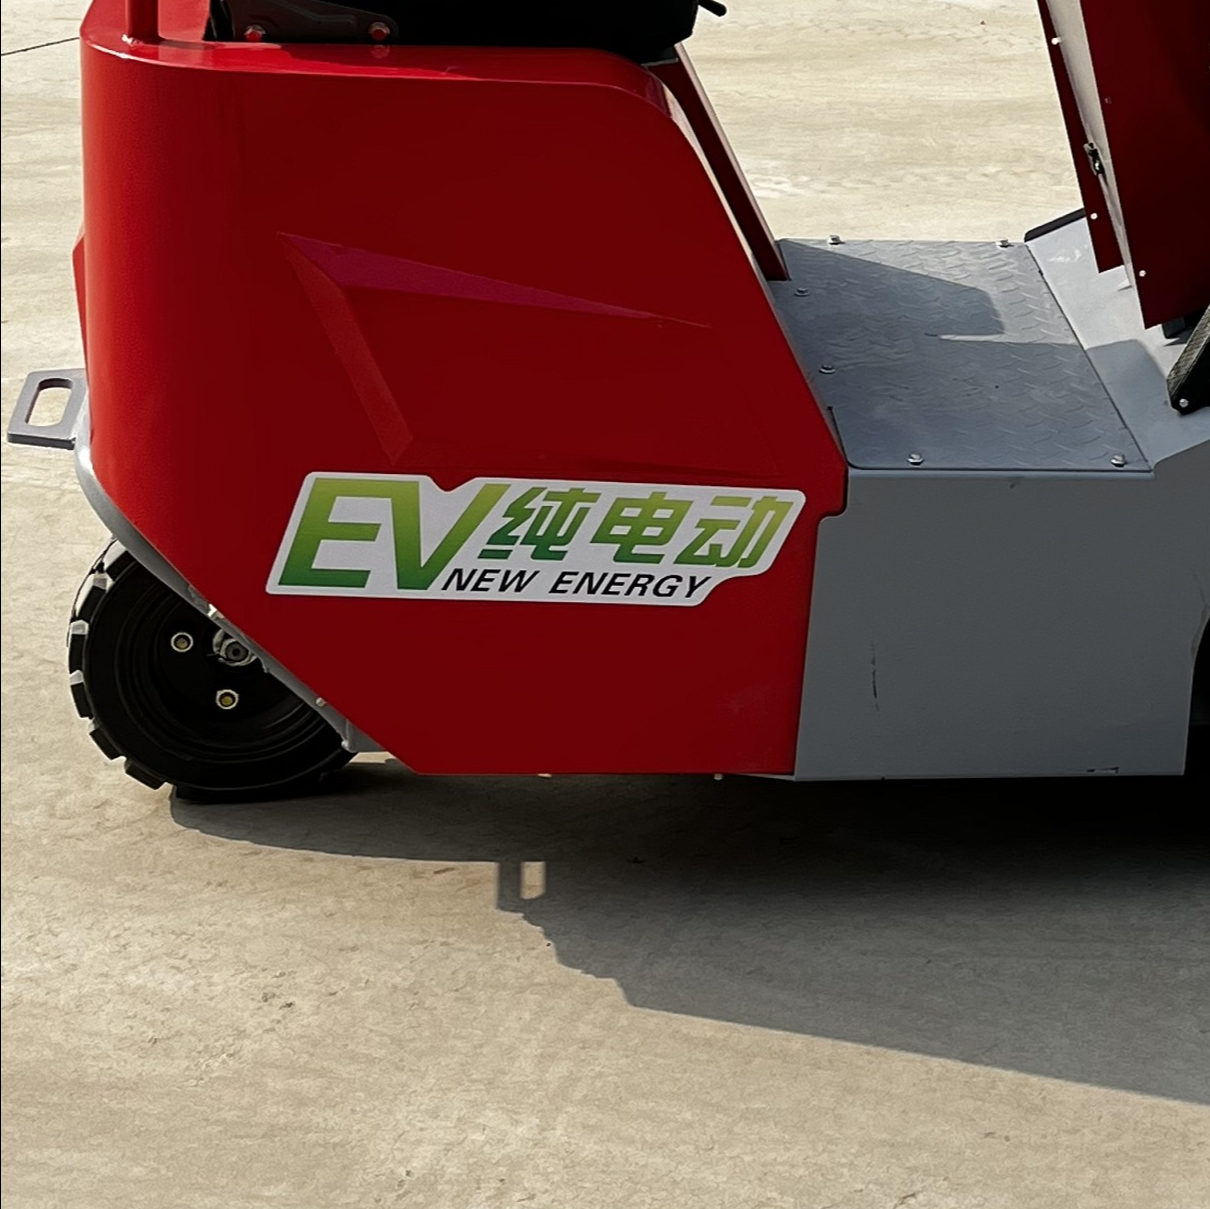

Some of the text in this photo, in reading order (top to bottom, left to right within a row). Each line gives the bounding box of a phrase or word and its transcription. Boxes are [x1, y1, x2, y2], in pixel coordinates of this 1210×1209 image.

[278, 476, 794, 590] EV 纯电动
[441, 568, 711, 599] NEW ENERGY
